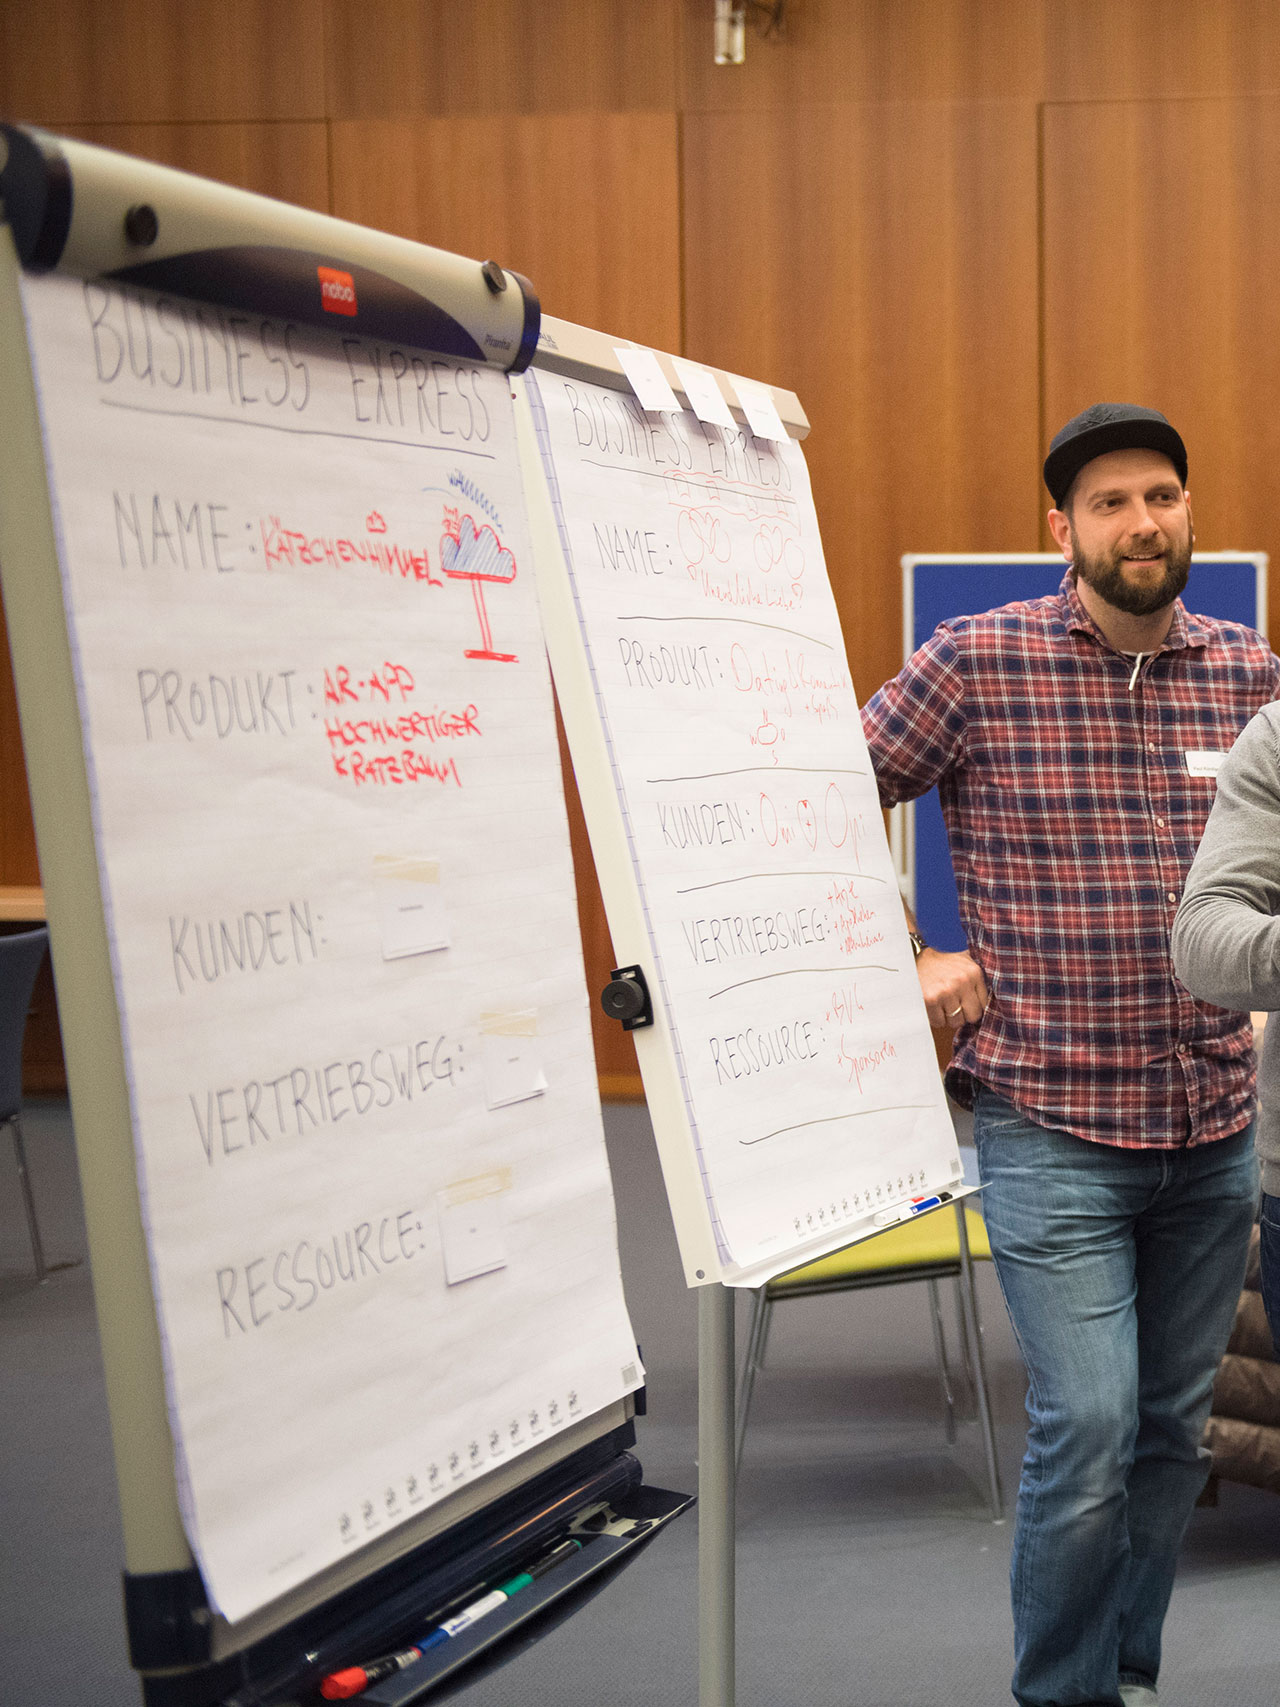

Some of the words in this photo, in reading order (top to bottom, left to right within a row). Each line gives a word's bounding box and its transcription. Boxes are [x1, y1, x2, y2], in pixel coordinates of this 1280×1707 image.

[321, 281, 354, 302] nobo
[83, 281, 311, 412] BUSINESS
[342, 339, 491, 442] EXPRESS
[563, 382, 693, 470] BUSINESS
[682, 907, 831, 966] VERTRIEBSWEG:
[708, 1020, 826, 1086] RESSOURCE:
[188, 1034, 466, 1167] VERTRIEBSWEG:
[215, 1210, 426, 1339] RESSOURCE:
